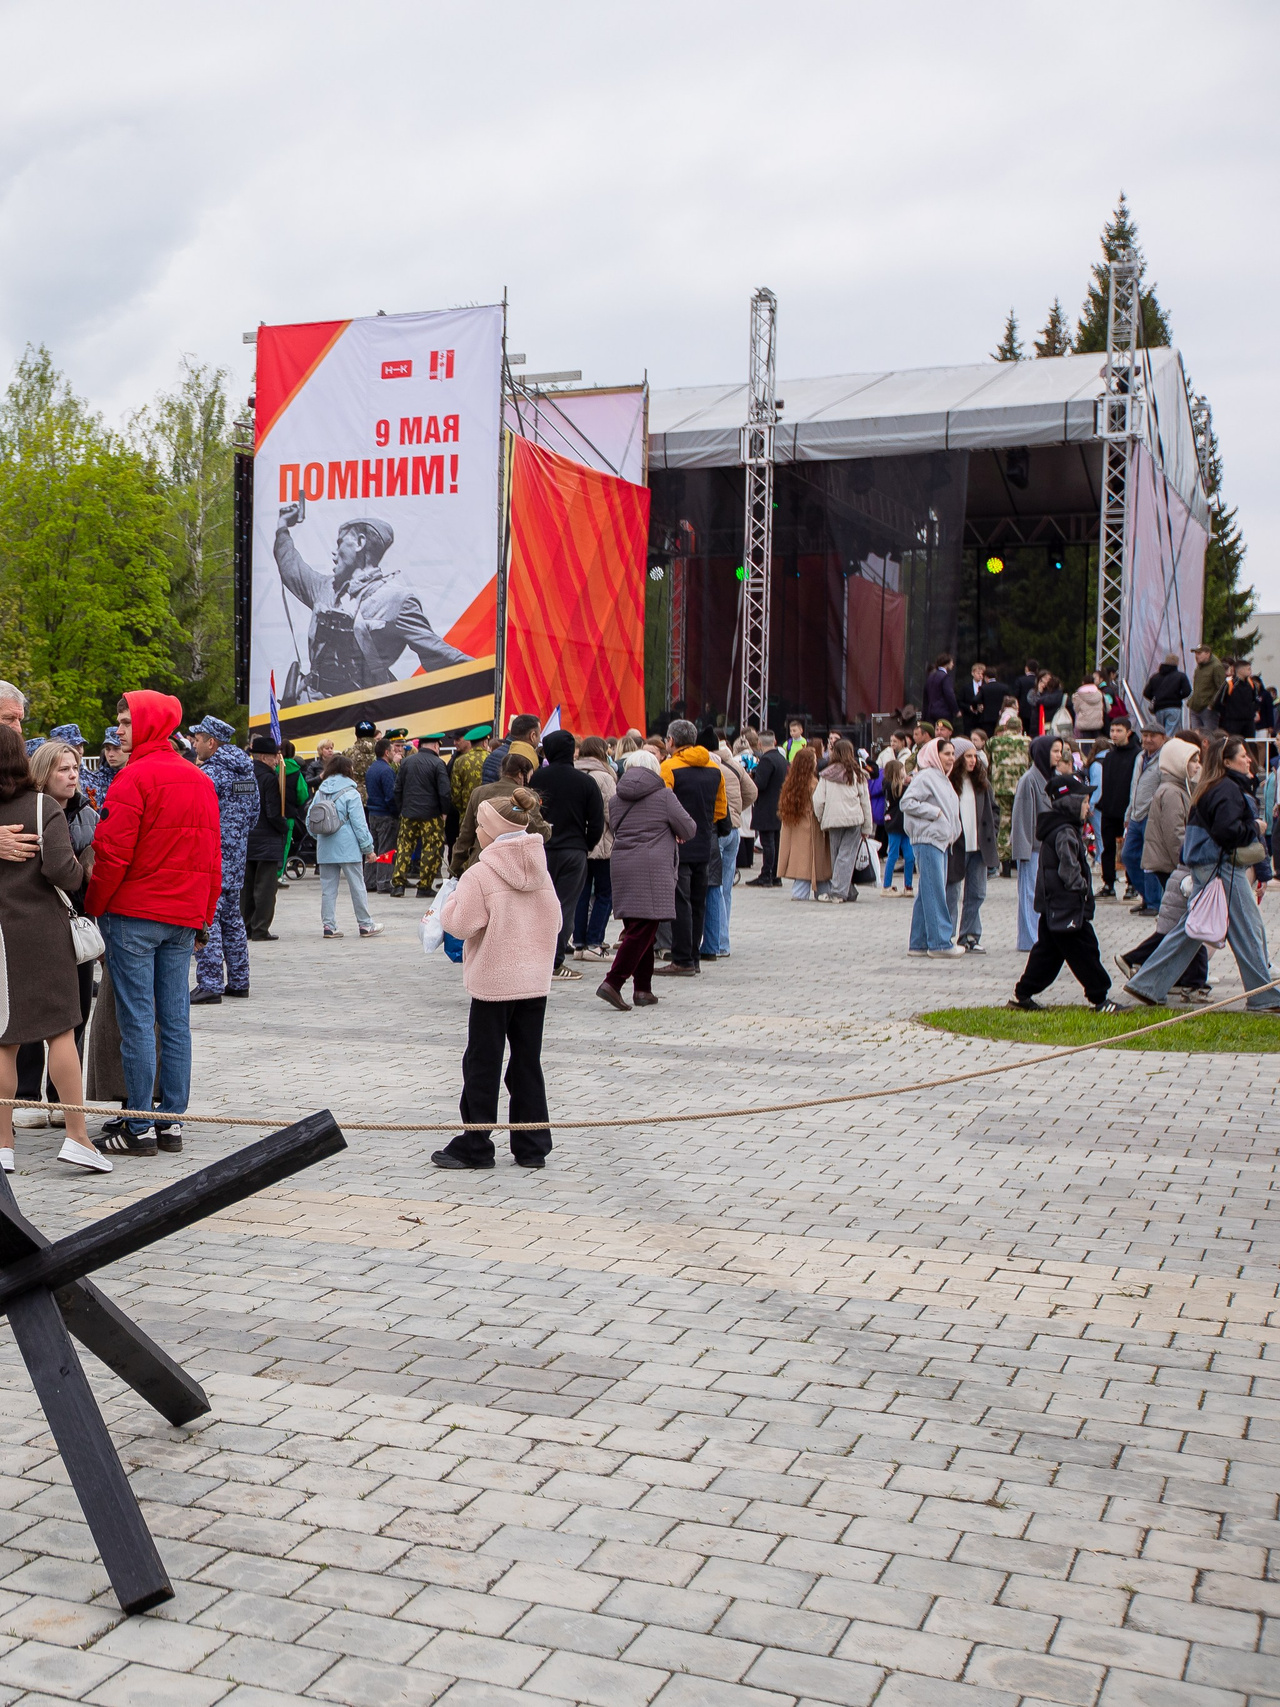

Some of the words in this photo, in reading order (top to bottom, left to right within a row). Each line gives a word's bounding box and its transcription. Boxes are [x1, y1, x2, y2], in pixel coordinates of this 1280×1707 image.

[375, 419, 390, 447] 9
[399, 414, 459, 445] МАЯ
[279, 454, 459, 502] ПОМНИМ!
